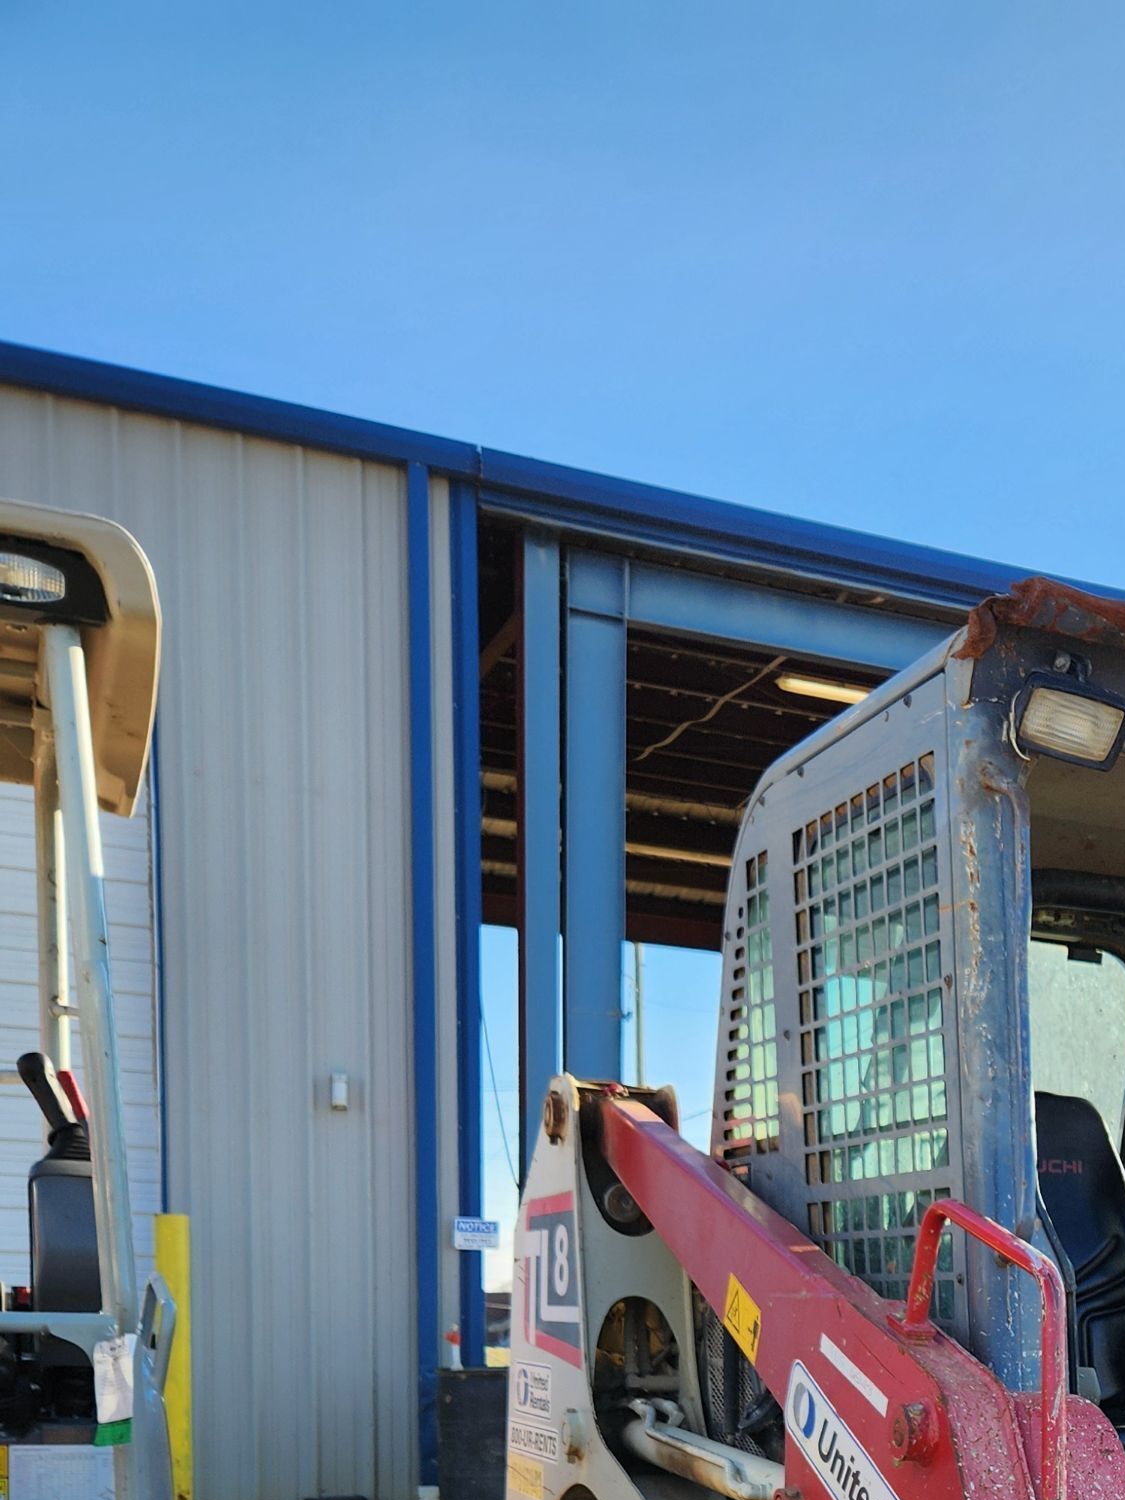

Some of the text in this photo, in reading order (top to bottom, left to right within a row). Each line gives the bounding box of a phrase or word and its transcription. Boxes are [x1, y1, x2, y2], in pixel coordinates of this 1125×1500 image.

[458, 1221, 496, 1231] NOTICE
[529, 1371, 549, 1391] United
[529, 1392, 550, 1412] Rentals
